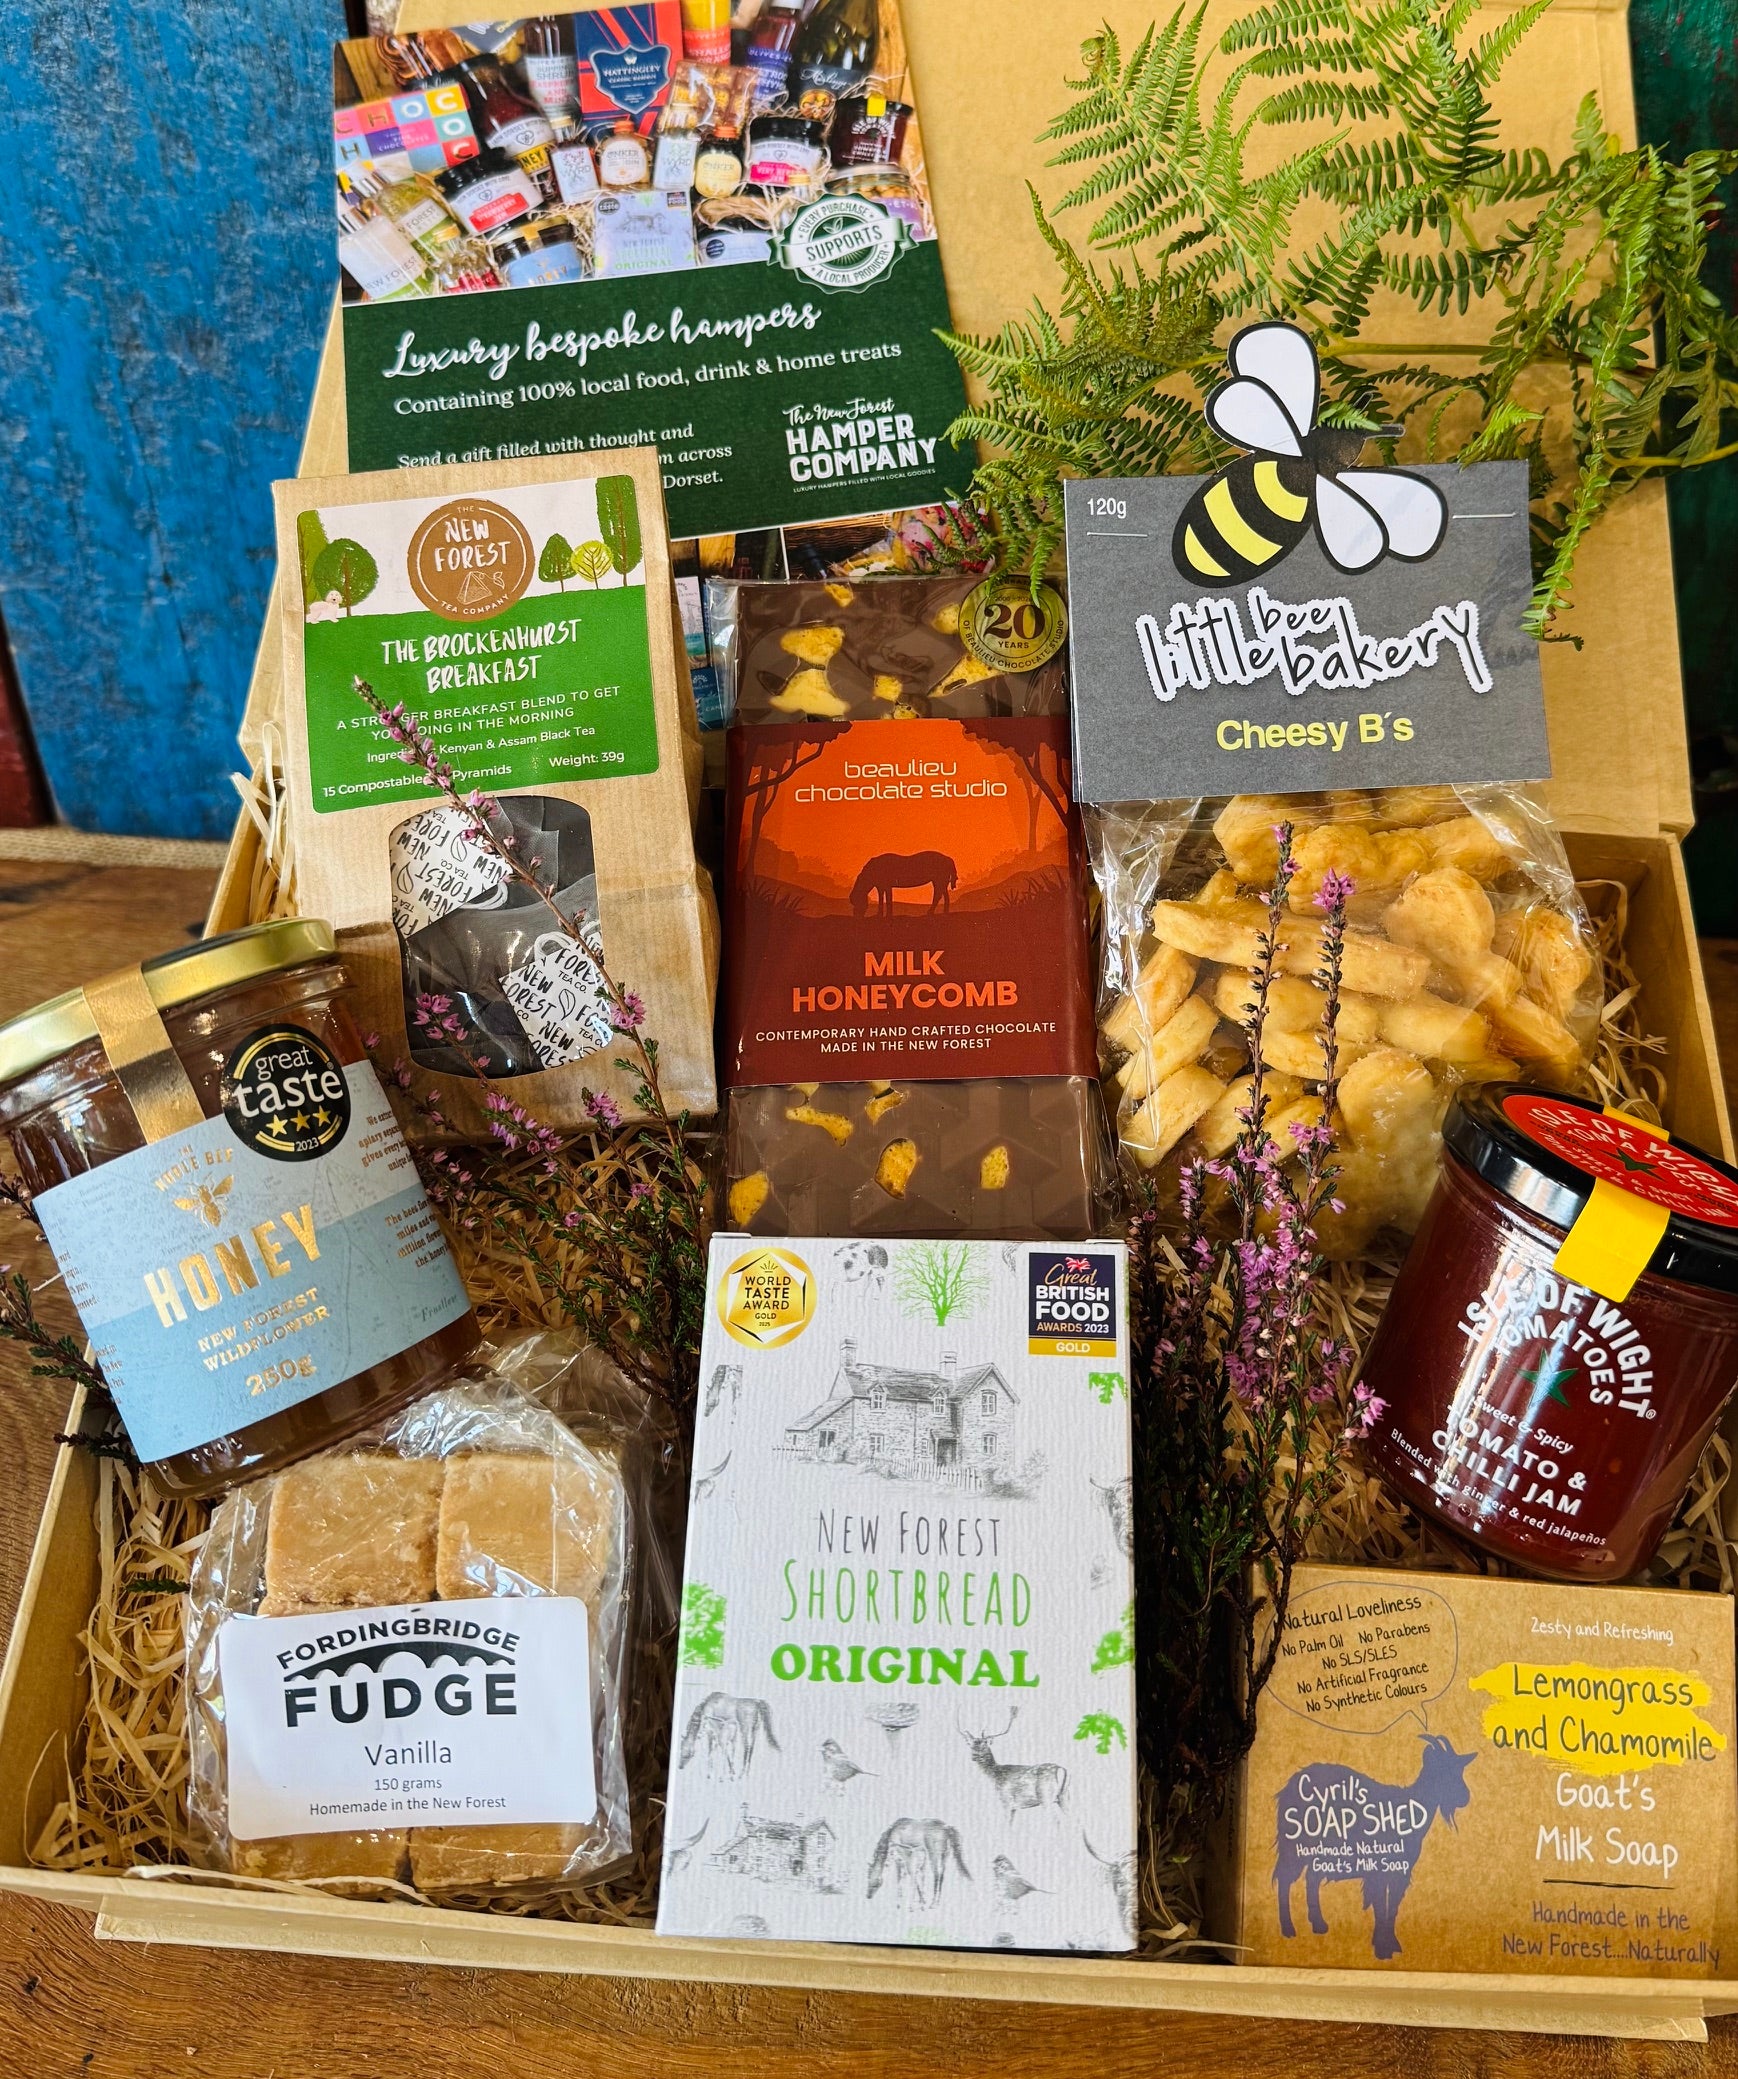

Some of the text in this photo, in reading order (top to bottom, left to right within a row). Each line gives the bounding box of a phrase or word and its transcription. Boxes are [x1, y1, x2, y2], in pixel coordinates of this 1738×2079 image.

[800, 202, 870, 233] EVERY PURCHASE
[806, 225, 883, 261] SUPPORTS
[824, 250, 890, 284] LOCAL PRODUCER
[382, 302, 822, 381] Luxury bespoke hampers
[393, 343, 902, 416] Containing 100% local food, drink home treats
[782, 397, 895, 427] The New Forest
[397, 429, 655, 469] Send filled with thought
[786, 413, 915, 455] HAMPER
[678, 444, 732, 462] across
[790, 437, 937, 483] COMPANY
[663, 470, 724, 490] Dorset.
[818, 482, 848, 491] HAMPERS
[886, 473, 906, 482] LOCAL
[906, 468, 936, 478] GOODIES
[1087, 498, 1127, 518] 120g
[445, 518, 489, 543] NEW
[434, 541, 511, 572] FOREST
[441, 593, 509, 615] TEA COMPANY
[1255, 595, 1331, 633] bee
[983, 604, 1045, 639] 20
[381, 619, 582, 665] THE BROCKENHURST
[965, 620, 1064, 669] BEAULIEU CHOCOLATE STUDIO
[998, 641, 1030, 649] YEARS
[1145, 605, 1484, 693] little bakery
[426, 654, 542, 694] BREAKFAST
[434, 686, 620, 720] BREAKFAST BLEND GET
[509, 708, 574, 726] MORNING
[439, 727, 595, 756] Kenyan Assam Black Tea
[1217, 719, 1348, 752] Cheesy
[338, 751, 625, 794] Compostable Pyramids Weight: 39g
[844, 759, 957, 779] beaulieu
[795, 779, 1008, 803] chocolate studio
[518, 965, 553, 992] NEW
[865, 950, 945, 977] MILK
[792, 980, 1018, 1013] HONEYCOMB
[539, 1022, 573, 1050] NEW
[755, 1022, 1056, 1042] CONTEMPORARY HAND CRAFTED CHOCOLATE
[821, 1037, 992, 1053] MADE NEW FOREST
[255, 1045, 313, 1081] great
[233, 1069, 343, 1118] taste
[1528, 1107, 1588, 1128] ISLE
[1590, 1118, 1635, 1140] OF
[296, 1136, 320, 1152] 2023
[1567, 1127, 1702, 1191] TOMATOES
[144, 1204, 321, 1328] HONEY
[745, 1276, 791, 1286] WORLD
[1044, 1263, 1098, 1287] Great
[743, 1300, 790, 1310] AWARD
[744, 1287, 790, 1299] TASTE
[1036, 1285, 1109, 1301] BRITISH
[198, 1287, 318, 1352] NEW FOREST
[1036, 1301, 1110, 1322] FOOD
[1457, 1277, 1527, 1344] ISLE
[1538, 1281, 1588, 1315] OF
[203, 1305, 330, 1371] WILDFLOWER
[1036, 1322, 1109, 1333] AWARDS 2023
[1056, 1342, 1090, 1353] GOLD
[1497, 1315, 1614, 1406] TOMATOES
[246, 1355, 317, 1396] 250g
[1447, 1404, 1559, 1479] TOMATO
[1534, 1428, 1574, 1455] Spicy
[1391, 1428, 1607, 1546] Blended jalapeños
[1431, 1429, 1582, 1517] CHILLI JAM
[1282, 1596, 1422, 1630] Natural Loveliness
[276, 1617, 520, 1670] FORDINGBRIDGE
[1299, 1622, 1431, 1653] Palm No Parabens
[1531, 1617, 1674, 1647] Zesty Refreshing
[771, 1643, 1040, 1688] ORIGINAL
[1340, 1645, 1398, 1667] SLS/SLES
[1316, 1661, 1429, 1691] Artificial Fragrance
[1513, 1664, 1693, 1715] Lemongrass
[284, 1673, 518, 1728] FUDGE
[1324, 1682, 1427, 1712] Synthetic Colours
[1493, 1714, 1717, 1761] and Chamomile
[364, 1740, 452, 1767] Vanilla
[374, 1777, 442, 1792] 150 grams
[1299, 1774, 1368, 1812] Cyril's
[1556, 1772, 1656, 1811] Goat's
[309, 1795, 506, 1816] Homemade New Forest
[1284, 1799, 1428, 1840] SOAP SHED
[1296, 1839, 1404, 1857] Handmade Natural
[1535, 1824, 1678, 1879] Milk Soap
[1312, 1857, 1409, 1875] Goat's Milk Soap
[1532, 1900, 1627, 1928] Handmade
[1503, 1933, 1543, 1955] New
